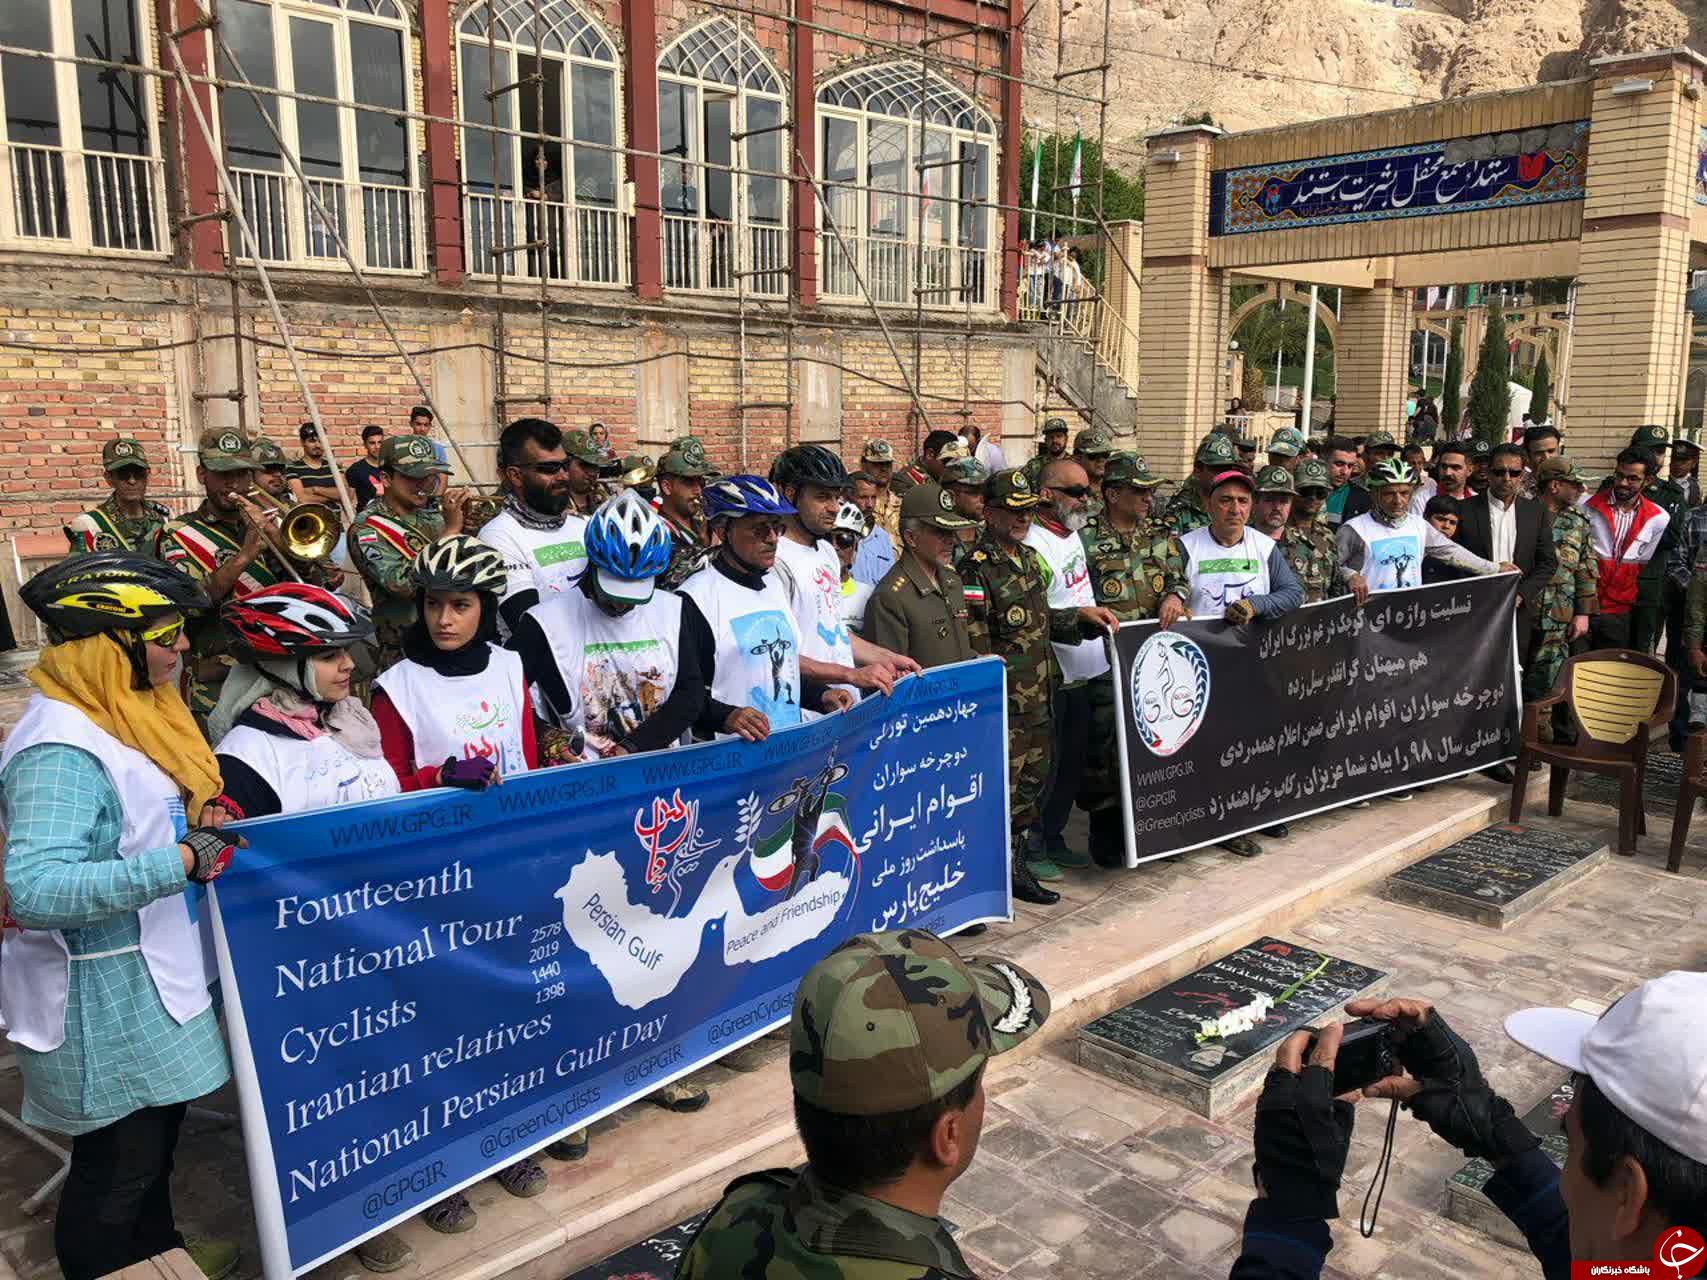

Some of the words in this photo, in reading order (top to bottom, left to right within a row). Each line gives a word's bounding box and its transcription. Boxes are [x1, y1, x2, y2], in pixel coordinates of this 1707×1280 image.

[1292, 171, 1350, 205] هستند
[1339, 163, 1399, 211] بشریت
[1392, 156, 1446, 208] محفل
[1369, 604, 1391, 633] ای
[1395, 601, 1427, 629] واژه
[1430, 594, 1472, 622] تسلیت
[1259, 625, 1284, 659] ایران
[1363, 654, 1406, 682] میهنان
[1407, 651, 1428, 674] هم
[1287, 675, 1305, 700] زده
[1453, 683, 1505, 711] دوچرخه
[911, 698, 979, 734] چهاردهمین
[1325, 705, 1362, 739] ایرانی
[1364, 697, 1396, 731] اقوام
[1400, 692, 1450, 723] سواران
[919, 746, 968, 772] دوچرخه
[1219, 735, 1276, 768] همدردی
[1344, 753, 1367, 777] شما
[1369, 750, 1393, 775] بیاد
[1395, 746, 1409, 772] را
[1410, 739, 1433, 763] ۹۸
[1437, 736, 1463, 763] سال
[642, 751, 745, 786] WWW.GPG.IR
[872, 760, 917, 791] سواران
[1304, 763, 1344, 795] عزیزان
[502, 774, 617, 813] WWW.GPG.IR
[926, 772, 983, 825] اقوام
[1209, 795, 1225, 821] زد
[1226, 780, 1271, 811] خواهند
[329, 802, 473, 849] WWW.GPG.IR
[852, 791, 922, 854] ایرانی
[916, 829, 966, 862] پاسداشت
[871, 857, 896, 888] ملی
[899, 855, 917, 877] روز
[273, 860, 473, 930] Fourteenth
[919, 860, 966, 911] خلیج
[726, 929, 759, 956] Peace
[760, 916, 779, 936] and
[780, 889, 841, 923] Friendship
[871, 881, 918, 933] پارس
[530, 921, 562, 944] 2578
[581, 892, 627, 945] Persian
[628, 935, 664, 971] Gulf
[274, 926, 437, 998] National
[440, 911, 523, 952] Tour
[528, 940, 560, 964] 2019
[532, 960, 561, 985] 1440
[535, 981, 566, 1005] 1398
[280, 999, 417, 1065] Cyclists
[707, 991, 796, 1044] @GreenCyclist
[285, 1062, 413, 1136] Iranian
[421, 1013, 552, 1078] relatives
[623, 1042, 685, 1087] @GPGIR
[288, 1106, 433, 1204] National
[441, 1066, 546, 1130] Persian
[555, 1031, 617, 1078] Gulf
[621, 1013, 669, 1051] Day
[480, 1086, 602, 1159] @GreenCyclists
[362, 1158, 449, 1219] @GPGIR
